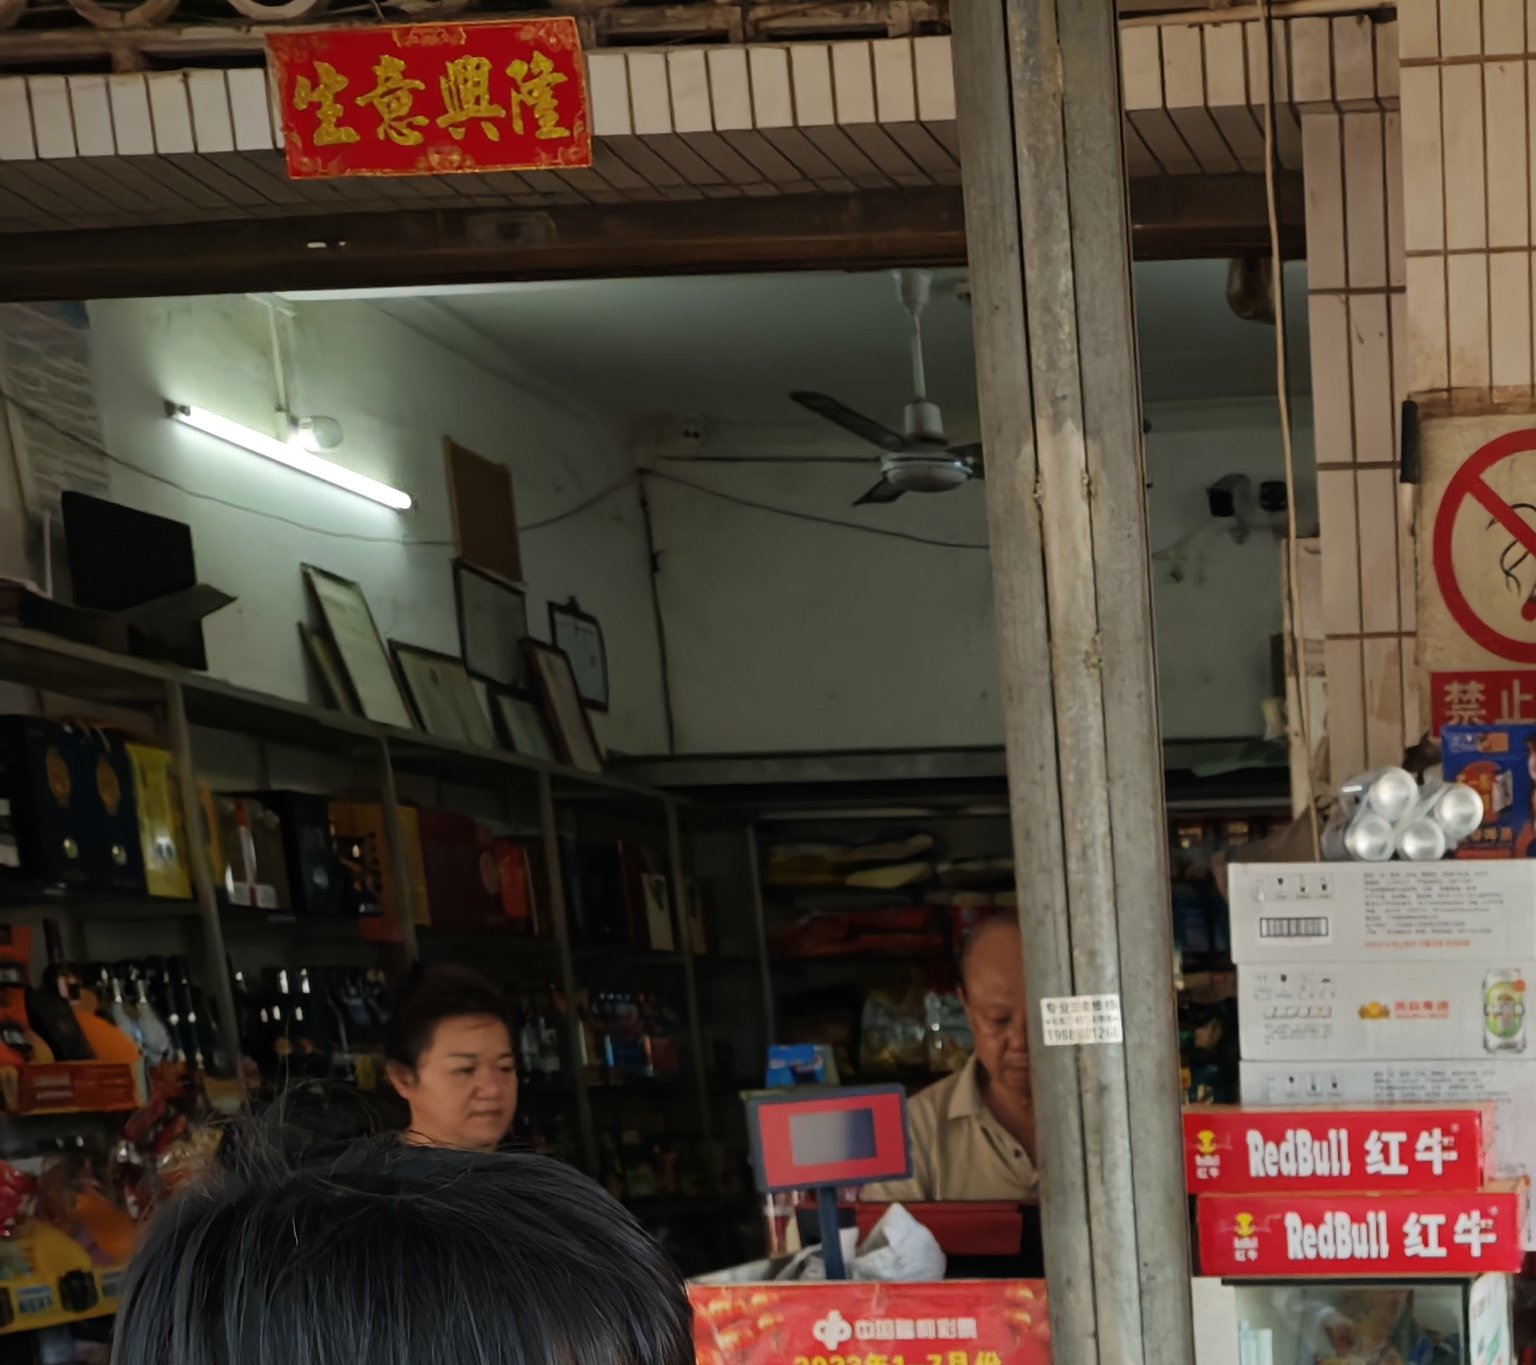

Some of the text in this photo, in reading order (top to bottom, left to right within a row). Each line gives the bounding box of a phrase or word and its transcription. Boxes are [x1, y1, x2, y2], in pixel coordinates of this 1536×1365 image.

[292, 51, 571, 147] 生意興隆
[1245, 1128, 1351, 1177] RedBull
[1364, 1127, 1459, 1177] 红牛
[1284, 1211, 1389, 1260] RedBull
[1403, 1209, 1498, 1258] 红牛
